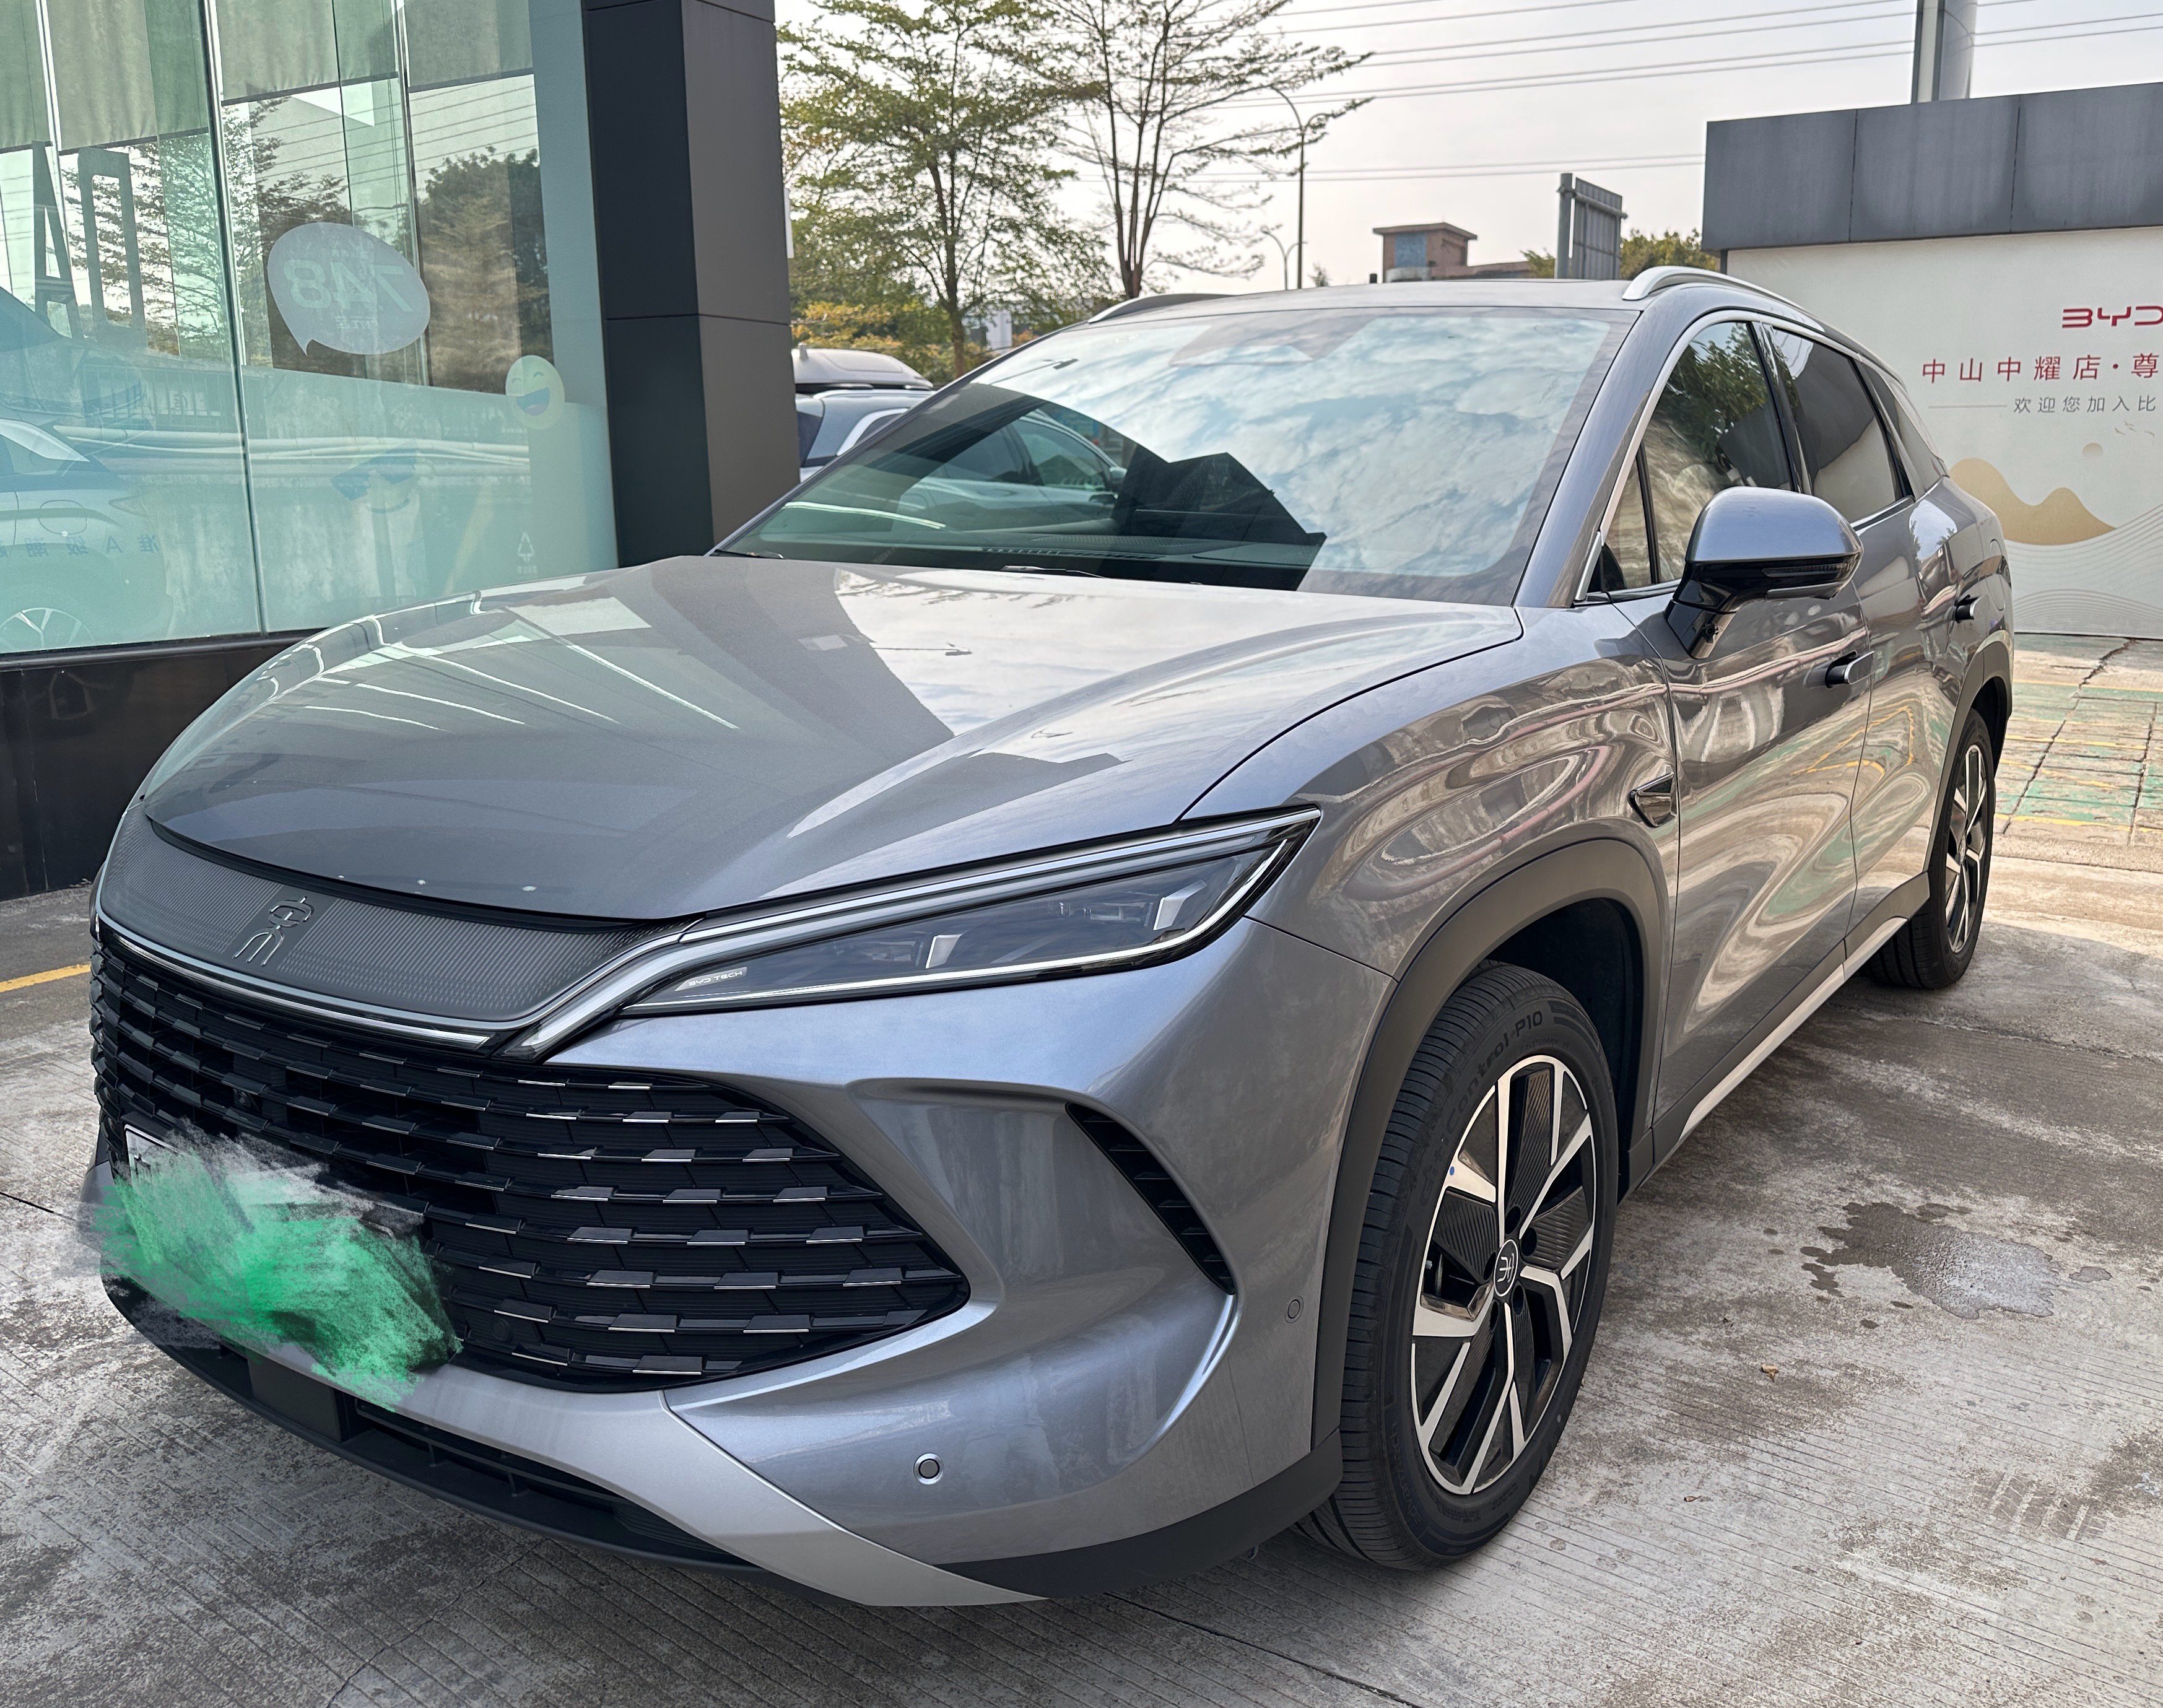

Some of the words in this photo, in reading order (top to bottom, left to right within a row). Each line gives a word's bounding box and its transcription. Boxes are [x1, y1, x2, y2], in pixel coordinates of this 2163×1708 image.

[2061, 306, 2163, 328] BYD
[2013, 394, 2156, 414] 欢迎您加入比
[688, 977, 712, 987] BYD
[713, 970, 742, 981] TECH
[1515, 1010, 1544, 1038] P10
